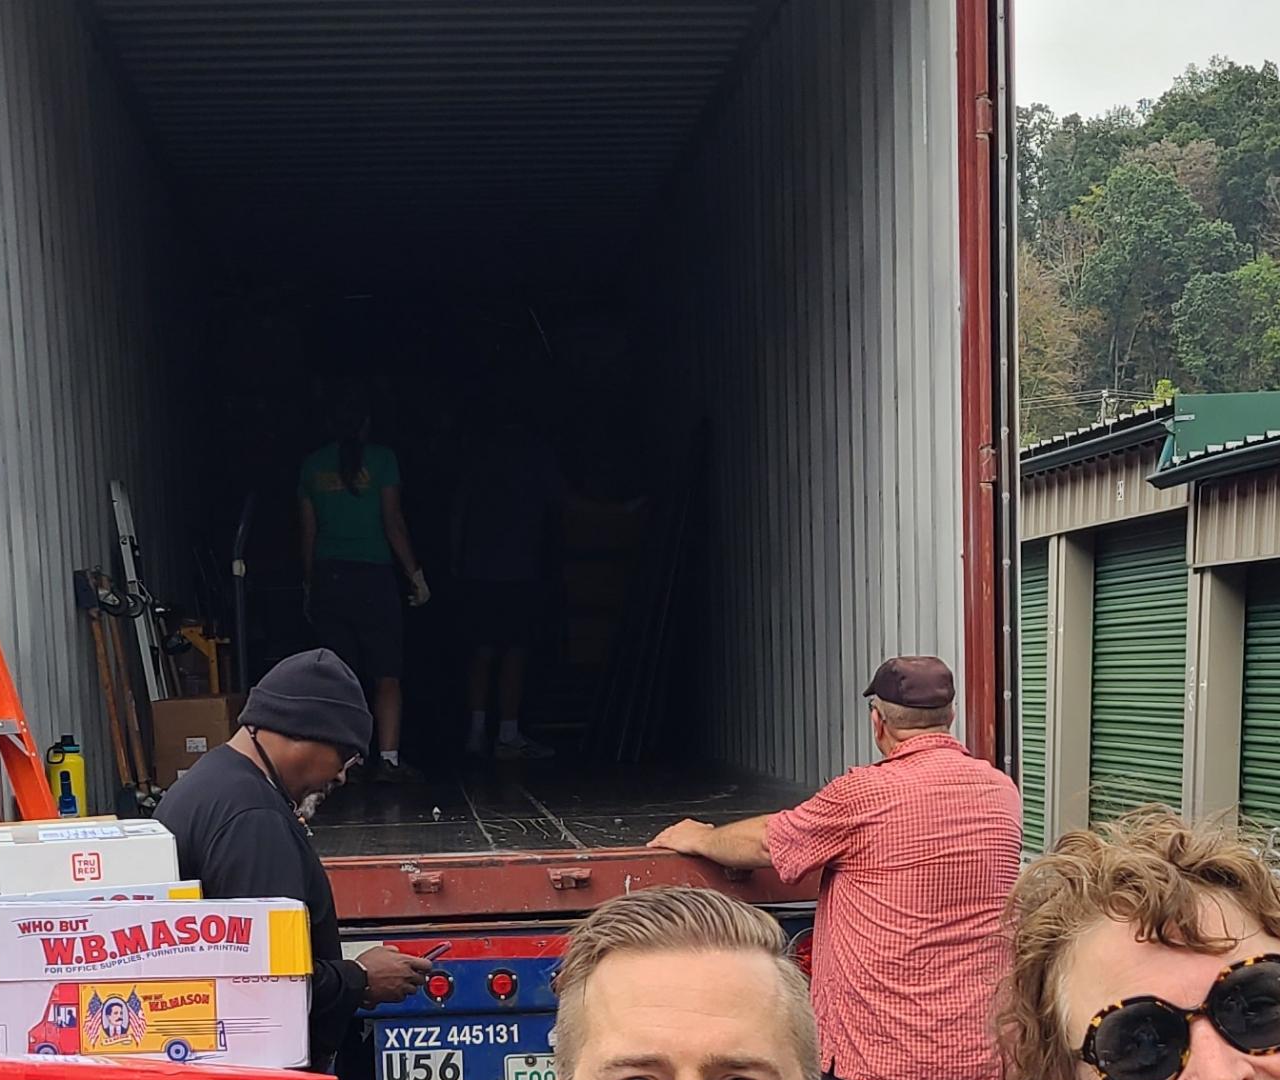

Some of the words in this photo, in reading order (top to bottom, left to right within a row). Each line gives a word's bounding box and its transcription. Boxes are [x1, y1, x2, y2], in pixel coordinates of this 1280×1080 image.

[17, 920, 54, 934] WHO
[59, 918, 89, 932] BUT
[40, 914, 253, 966] W.B.MASON
[65, 964, 98, 973] OFFICE
[100, 954, 145, 970] SUPPLIES,
[146, 946, 197, 958] FURNITURE
[207, 944, 249, 953] PRINTING
[385, 1027, 441, 1048] XYZZ
[447, 1024, 519, 1044] 445131
